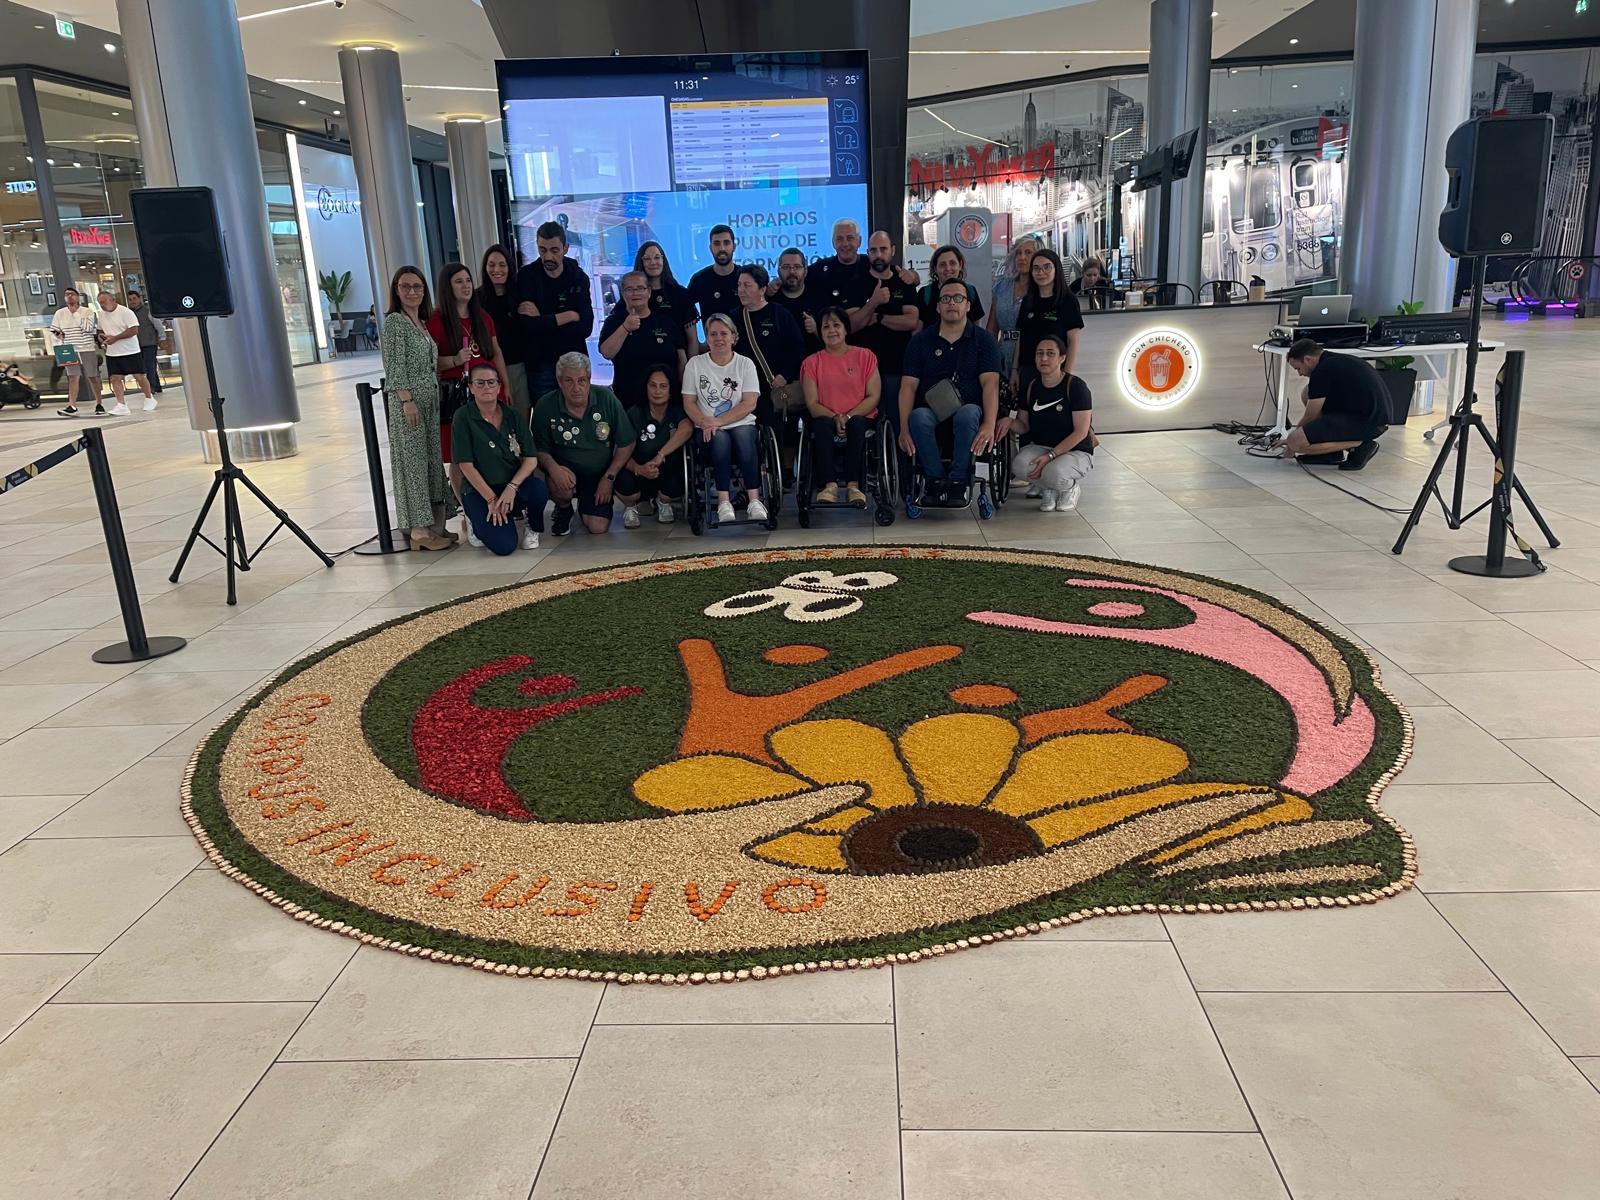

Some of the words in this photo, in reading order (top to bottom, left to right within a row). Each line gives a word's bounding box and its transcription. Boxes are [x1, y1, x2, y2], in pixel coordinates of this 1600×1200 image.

[673, 79, 700, 91] 11:31
[727, 210, 818, 229] HORARIOS
[795, 232, 818, 248] DE
[1131, 342, 1146, 358] DON
[1149, 336, 1190, 356] CHICHERO
[244, 692, 332, 820] CORPUS
[284, 818, 827, 922] INCLUSIVO
